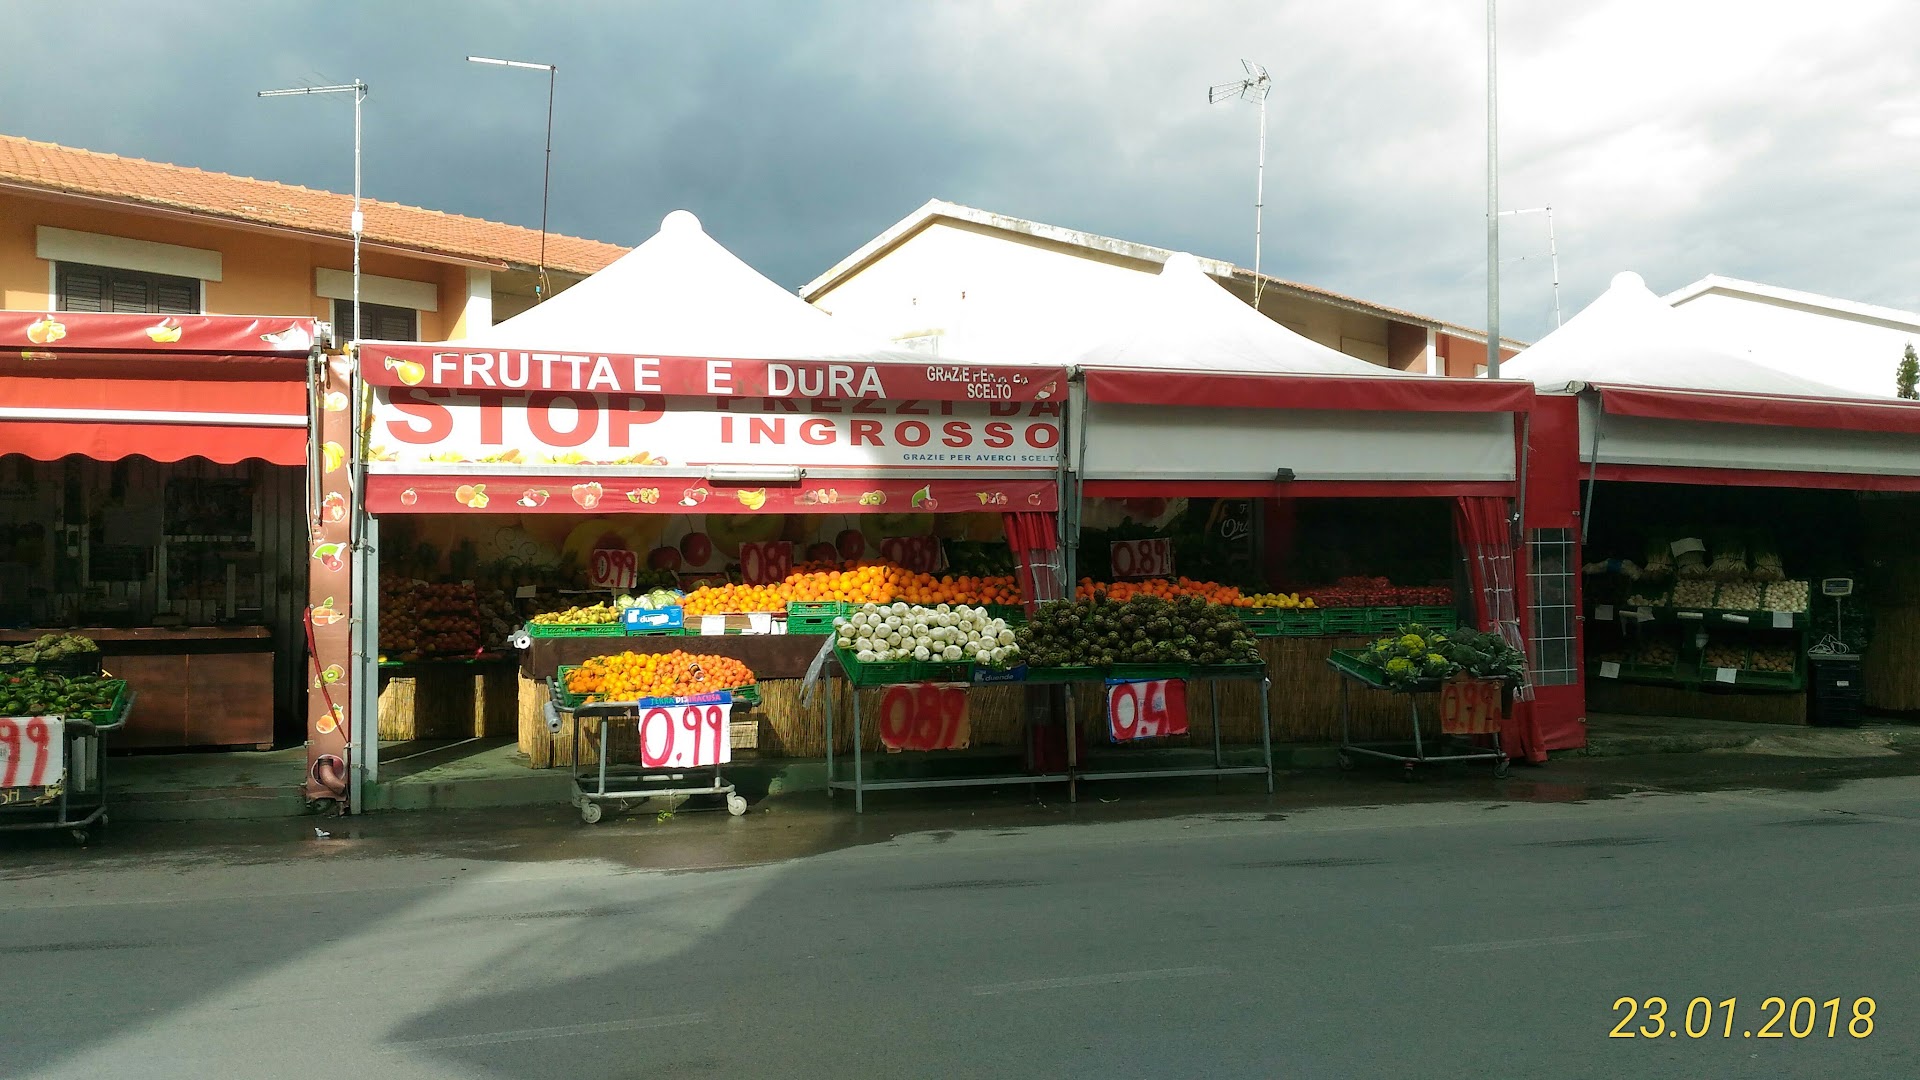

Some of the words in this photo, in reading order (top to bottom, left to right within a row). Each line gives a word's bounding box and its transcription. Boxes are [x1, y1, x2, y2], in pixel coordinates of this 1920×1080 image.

[706, 360, 733, 395] E
[967, 383, 1012, 399] SCELTO
[386, 388, 666, 446] STOP
[721, 417, 1059, 448] INGROSSO
[903, 453, 945, 462] GRAZIE
[950, 454, 971, 463] PER
[976, 454, 1016, 463] AVERCI
[593, 551, 636, 588] 0.99
[1112, 540, 1166, 576] 0.89
[641, 706, 722, 767] 0.99
